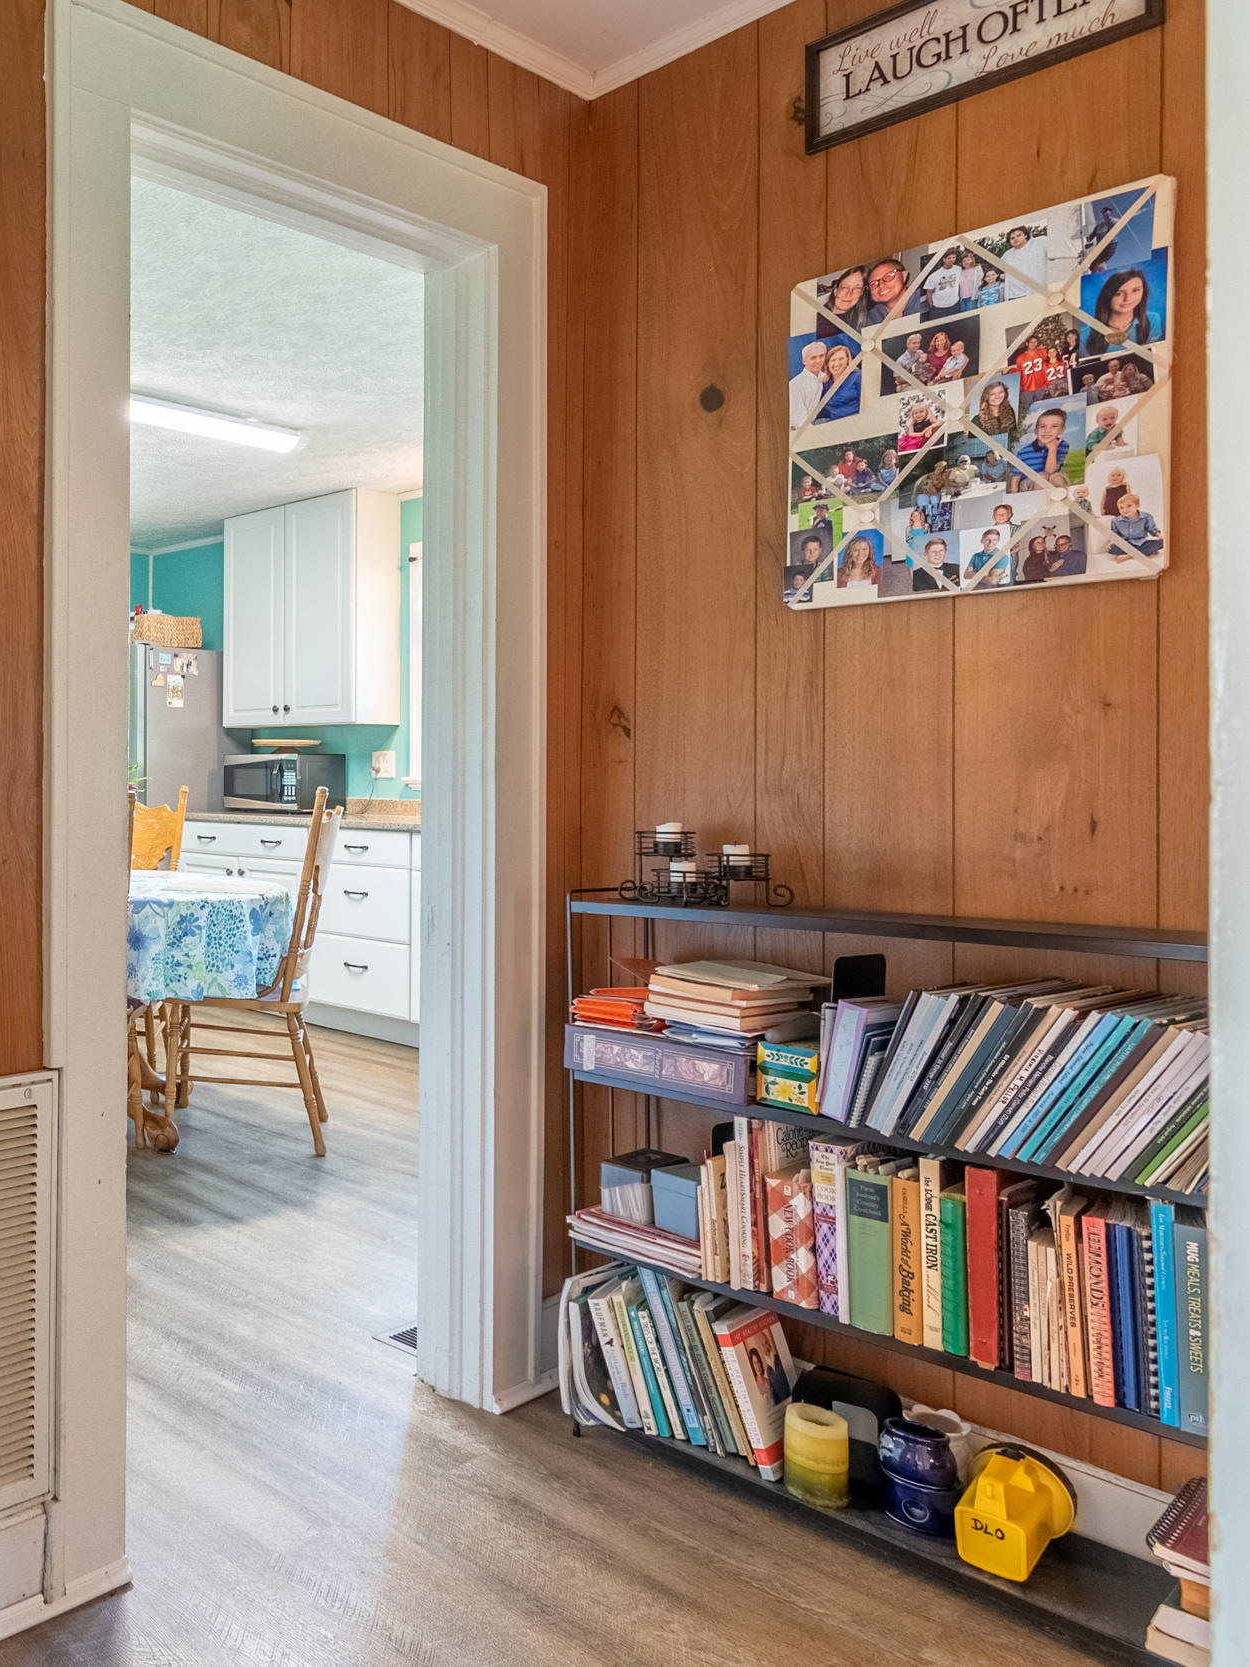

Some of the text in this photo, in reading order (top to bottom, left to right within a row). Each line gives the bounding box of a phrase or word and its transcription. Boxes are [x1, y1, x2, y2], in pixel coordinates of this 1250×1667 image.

[833, 9, 938, 75] Live well
[842, 0, 1091, 100] LAUGH OFT
[975, 2, 1121, 77] Love much
[1022, 358, 1043, 375] 23
[1046, 365, 1065, 381] 23
[1062, 353, 1077, 368] 54
[1021, 1046, 1045, 1073] VIRGINIA
[1016, 1073, 1025, 1082] M
[737, 1143, 746, 1168] SIMPLY
[781, 1137, 809, 1158] Recip
[817, 1185, 836, 1194] COOK
[924, 1176, 932, 1187] the
[924, 1187, 934, 1212] LODGE
[739, 1214, 749, 1248] COOKING
[898, 1212, 910, 1227] A
[923, 1212, 938, 1243] CAST
[783, 1203, 795, 1283] NEW COOK BOOK
[899, 1226, 913, 1256] World
[900, 1256, 911, 1267] of
[924, 1242, 939, 1272] IRON
[1064, 1251, 1073, 1274] WILD
[896, 1263, 917, 1316] Baking
[1065, 1274, 1077, 1328] PRESERVES
[591, 1300, 610, 1338] KAUFMAN
[1183, 1239, 1204, 1374] MUG MEALS, TREATS & SWEETS
[652, 1356, 664, 1378] WORLD
[971, 1517, 1005, 1541] DLO
